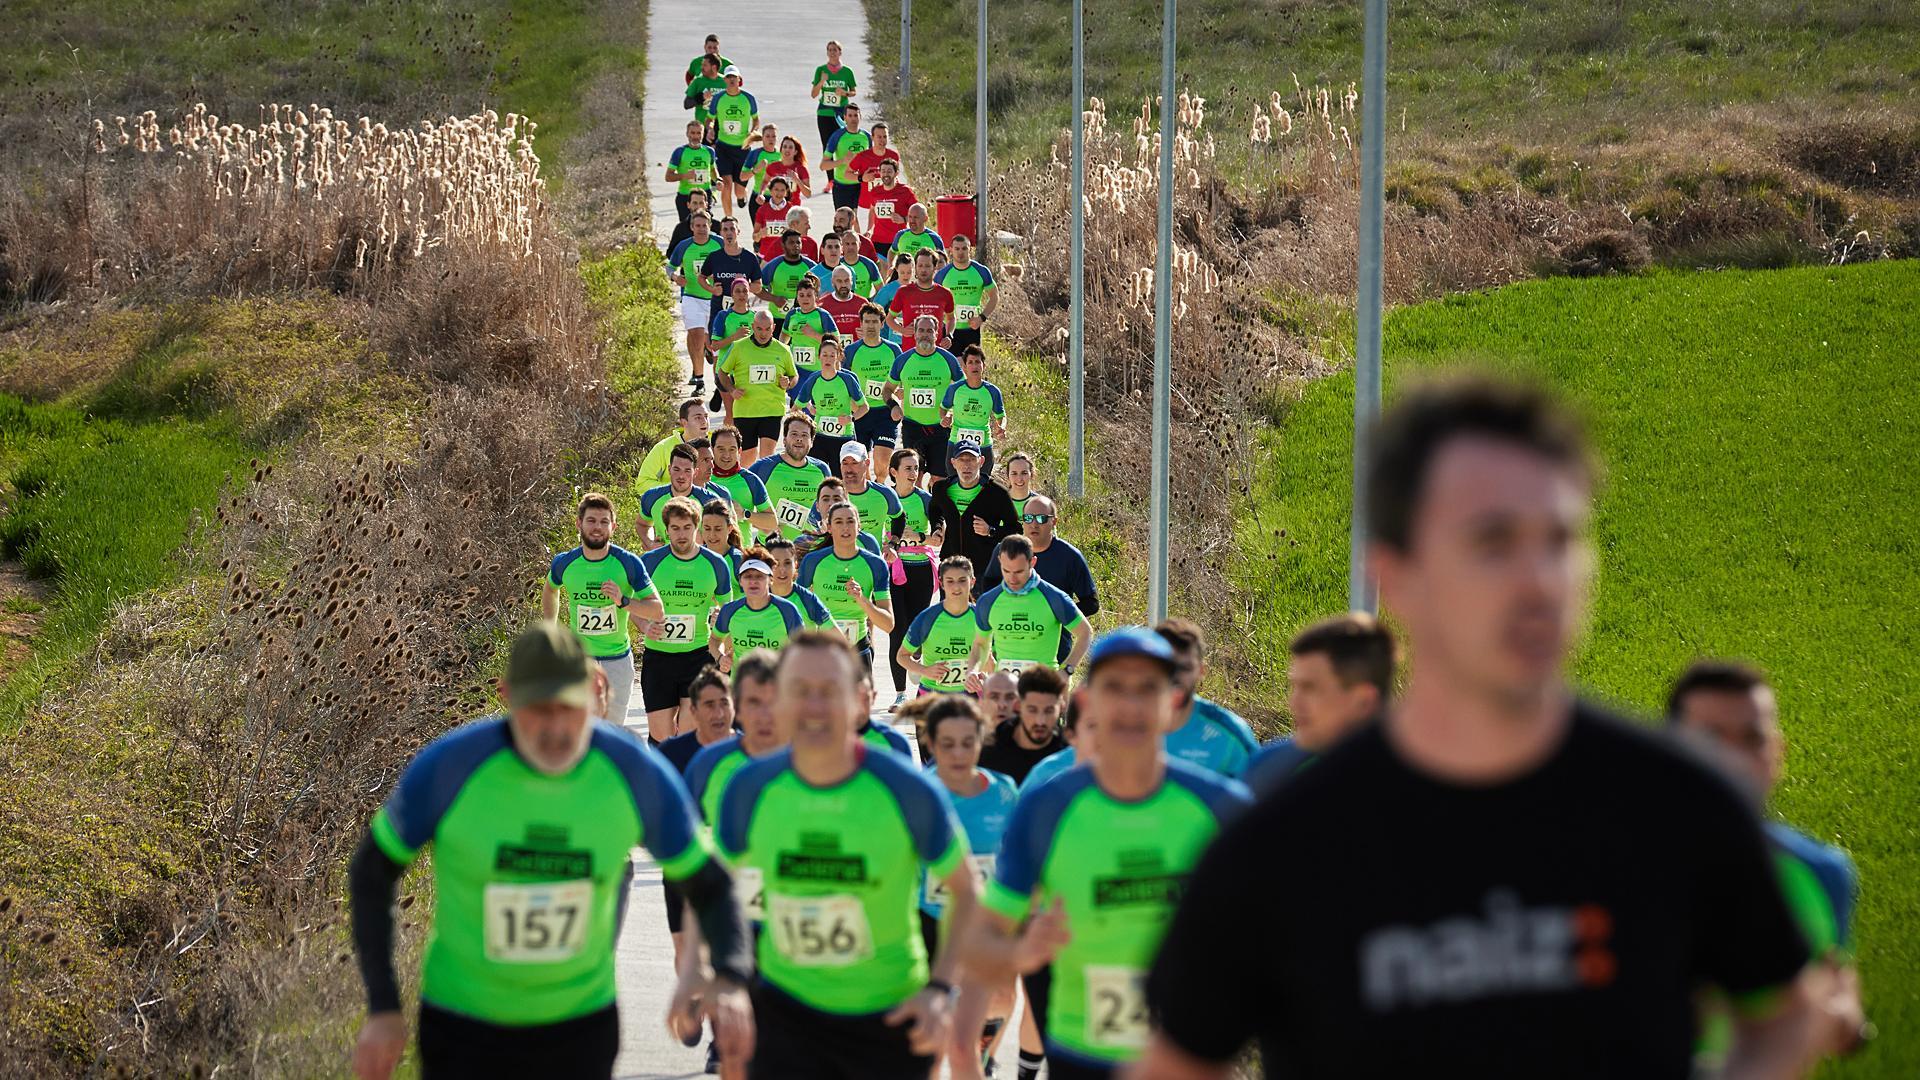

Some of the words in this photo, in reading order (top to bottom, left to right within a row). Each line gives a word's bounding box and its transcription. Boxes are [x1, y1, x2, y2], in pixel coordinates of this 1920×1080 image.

[826, 95, 838, 104] 30
[728, 124, 735, 132] 9
[877, 206, 892, 216] 153
[960, 309, 975, 320] 50
[795, 351, 811, 362] 112
[756, 370, 769, 381] 71
[868, 385, 883, 397] 10
[911, 393, 933, 405] 103
[821, 421, 843, 434] 109
[780, 505, 803, 526] 101
[659, 590, 708, 599] GARRIGUES
[580, 613, 615, 631] 224
[997, 621, 1045, 632] zabala
[664, 622, 687, 639] 92
[934, 645, 972, 655] zabal
[940, 667, 968, 684] 22
[502, 904, 579, 949] 157
[783, 915, 857, 957] 156
